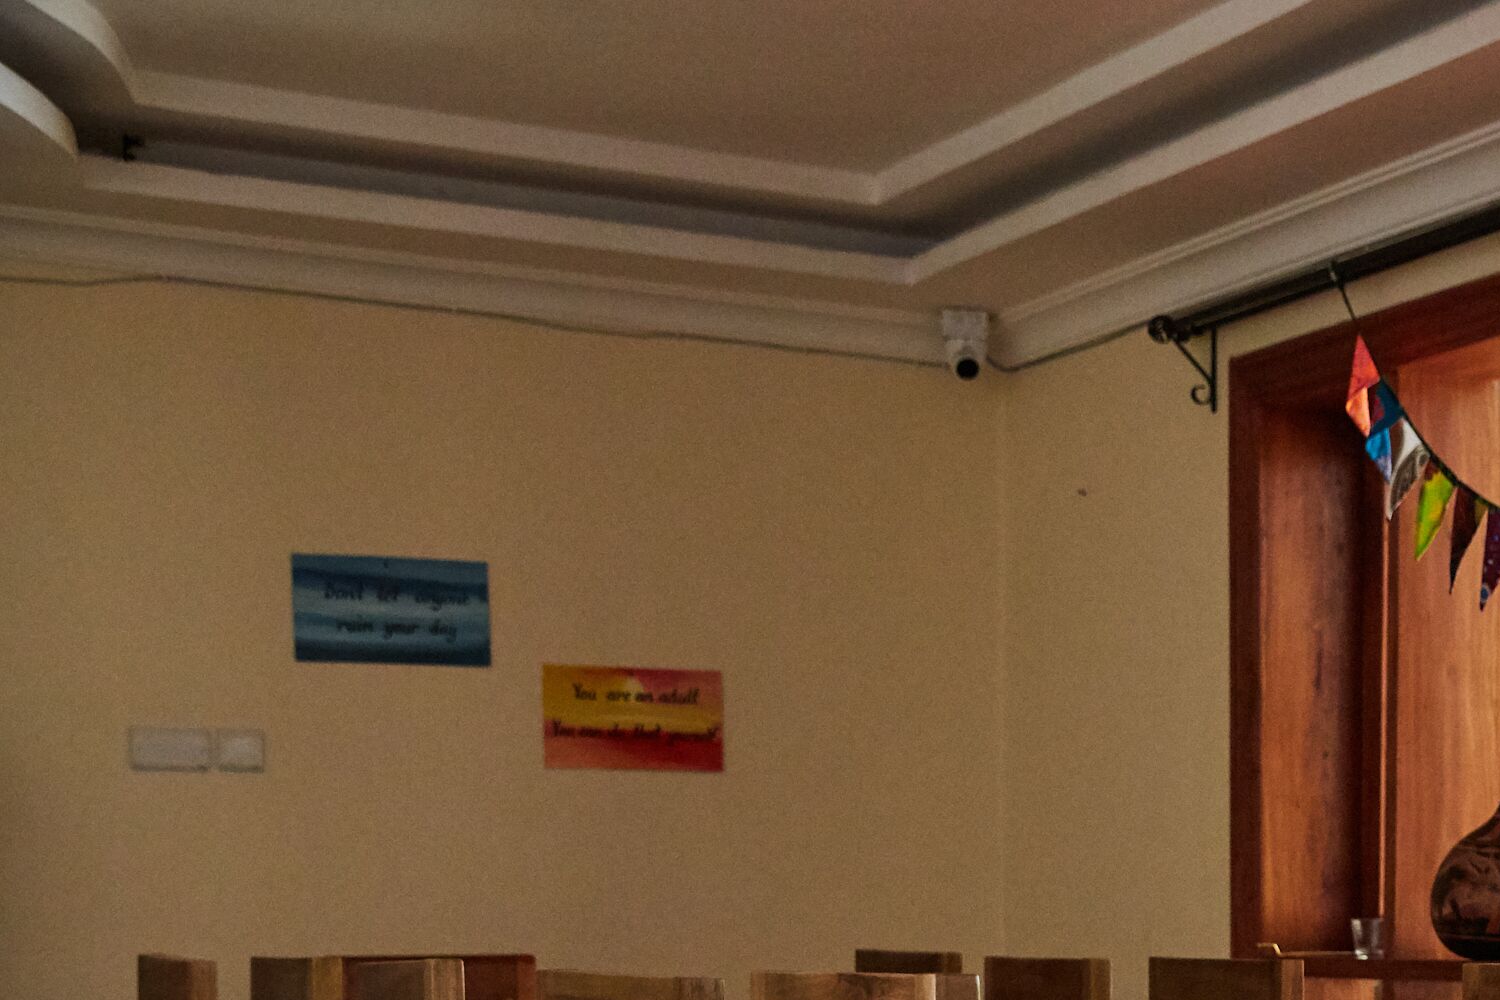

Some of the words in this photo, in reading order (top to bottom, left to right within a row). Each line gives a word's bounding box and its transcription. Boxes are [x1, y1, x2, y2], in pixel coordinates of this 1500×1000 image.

[429, 618, 457, 643] day
[572, 682, 597, 701] You
[606, 691, 631, 702] are
[635, 692, 654, 703] an
[553, 719, 576, 738] You
